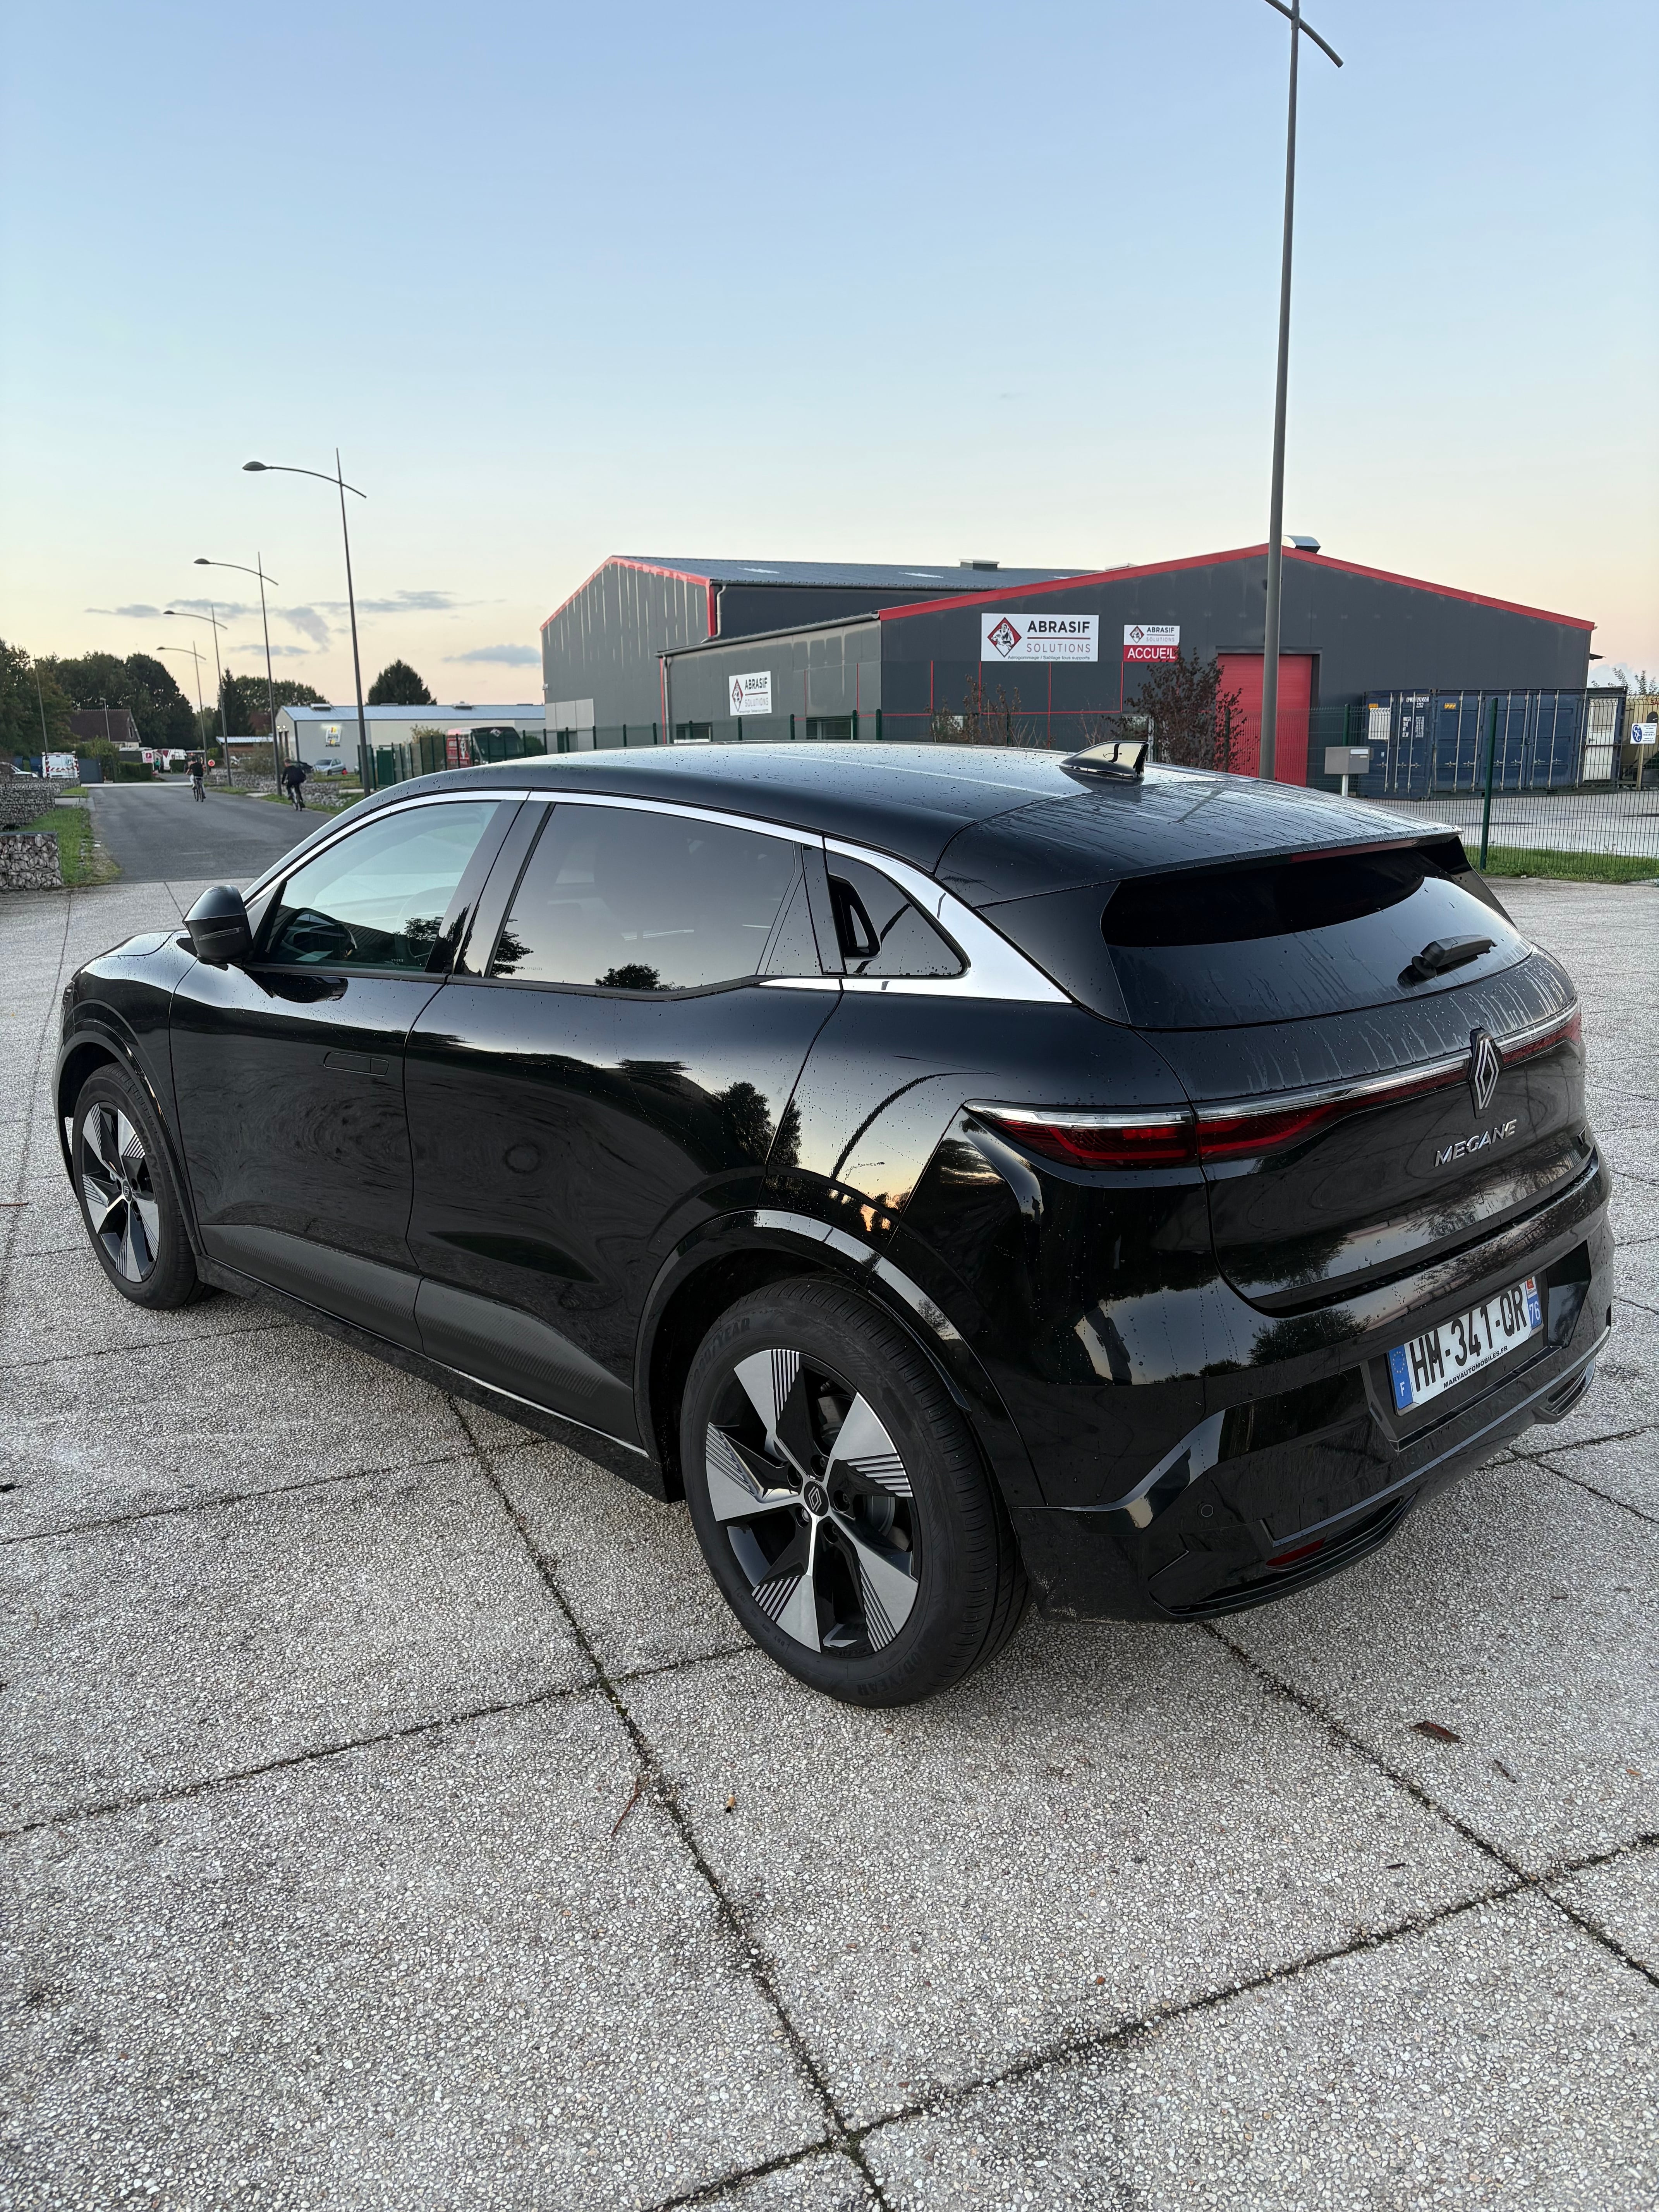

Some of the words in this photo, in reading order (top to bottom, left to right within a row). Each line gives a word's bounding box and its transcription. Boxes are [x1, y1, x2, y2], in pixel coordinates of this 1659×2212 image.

[1027, 620, 1090, 633] ABRASIF
[1027, 643, 1091, 653] SOLUTIONS
[1127, 647, 1176, 659] ACCUEIL
[745, 677, 768, 690] ABRASIF
[1434, 1119, 1517, 1167] MEGANE
[1529, 1301, 1540, 1324] 76
[1409, 1286, 1527, 1392] HM-341-QR
[1443, 1345, 1508, 1389] MARYAUTOMOBILES.FR
[1400, 1381, 1405, 1396] F
